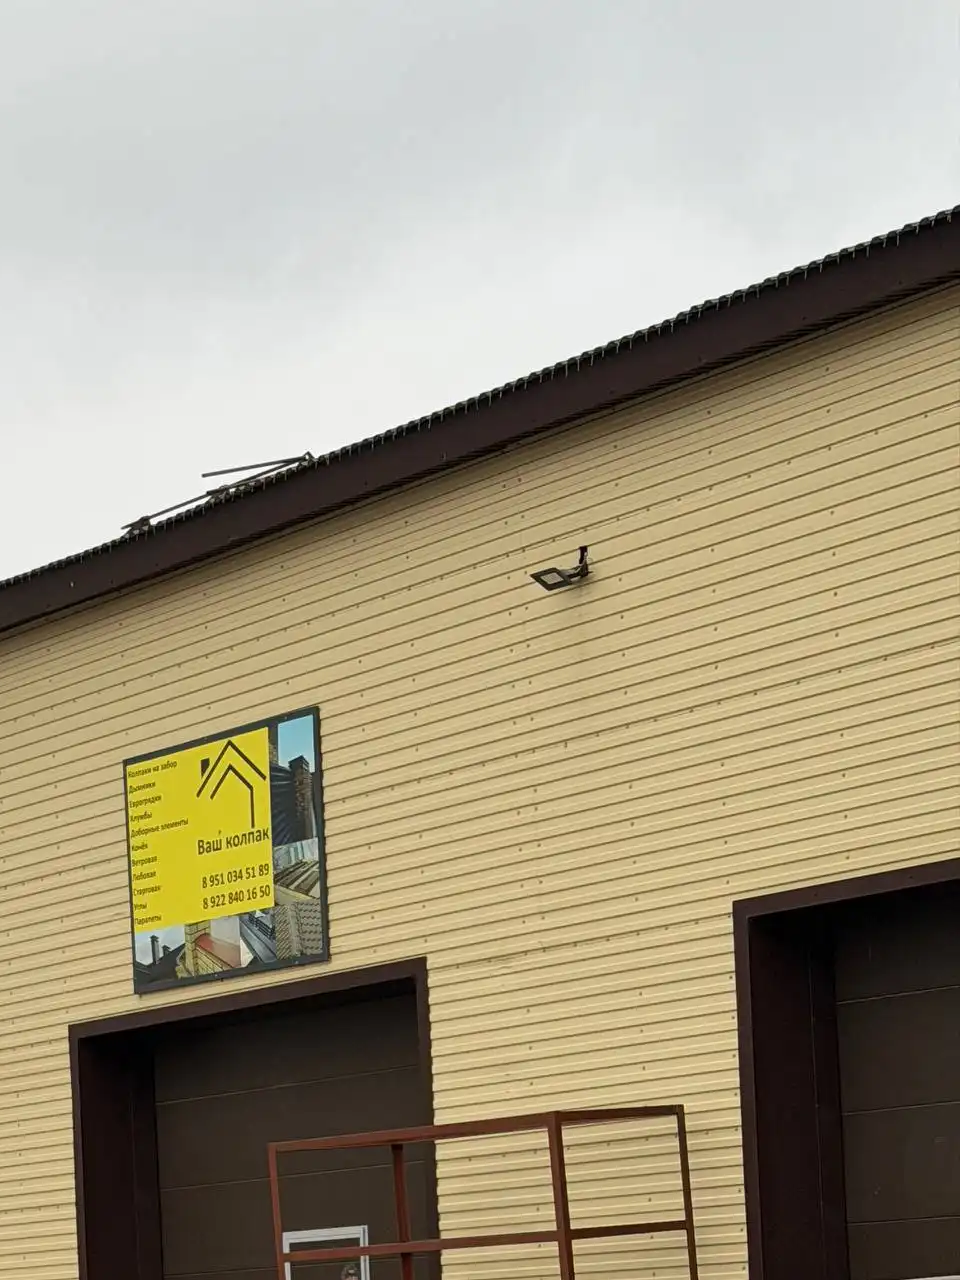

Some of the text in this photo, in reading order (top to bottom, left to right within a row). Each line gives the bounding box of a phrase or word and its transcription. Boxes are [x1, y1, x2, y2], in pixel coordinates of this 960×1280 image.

[161, 760, 178, 771] забор
[161, 818, 189, 831] элементы
[197, 827, 270, 855] Ваш колпак
[202, 863, 270, 889] 8 951 034 51 89
[203, 884, 271, 910] 8 922 840 16 50
